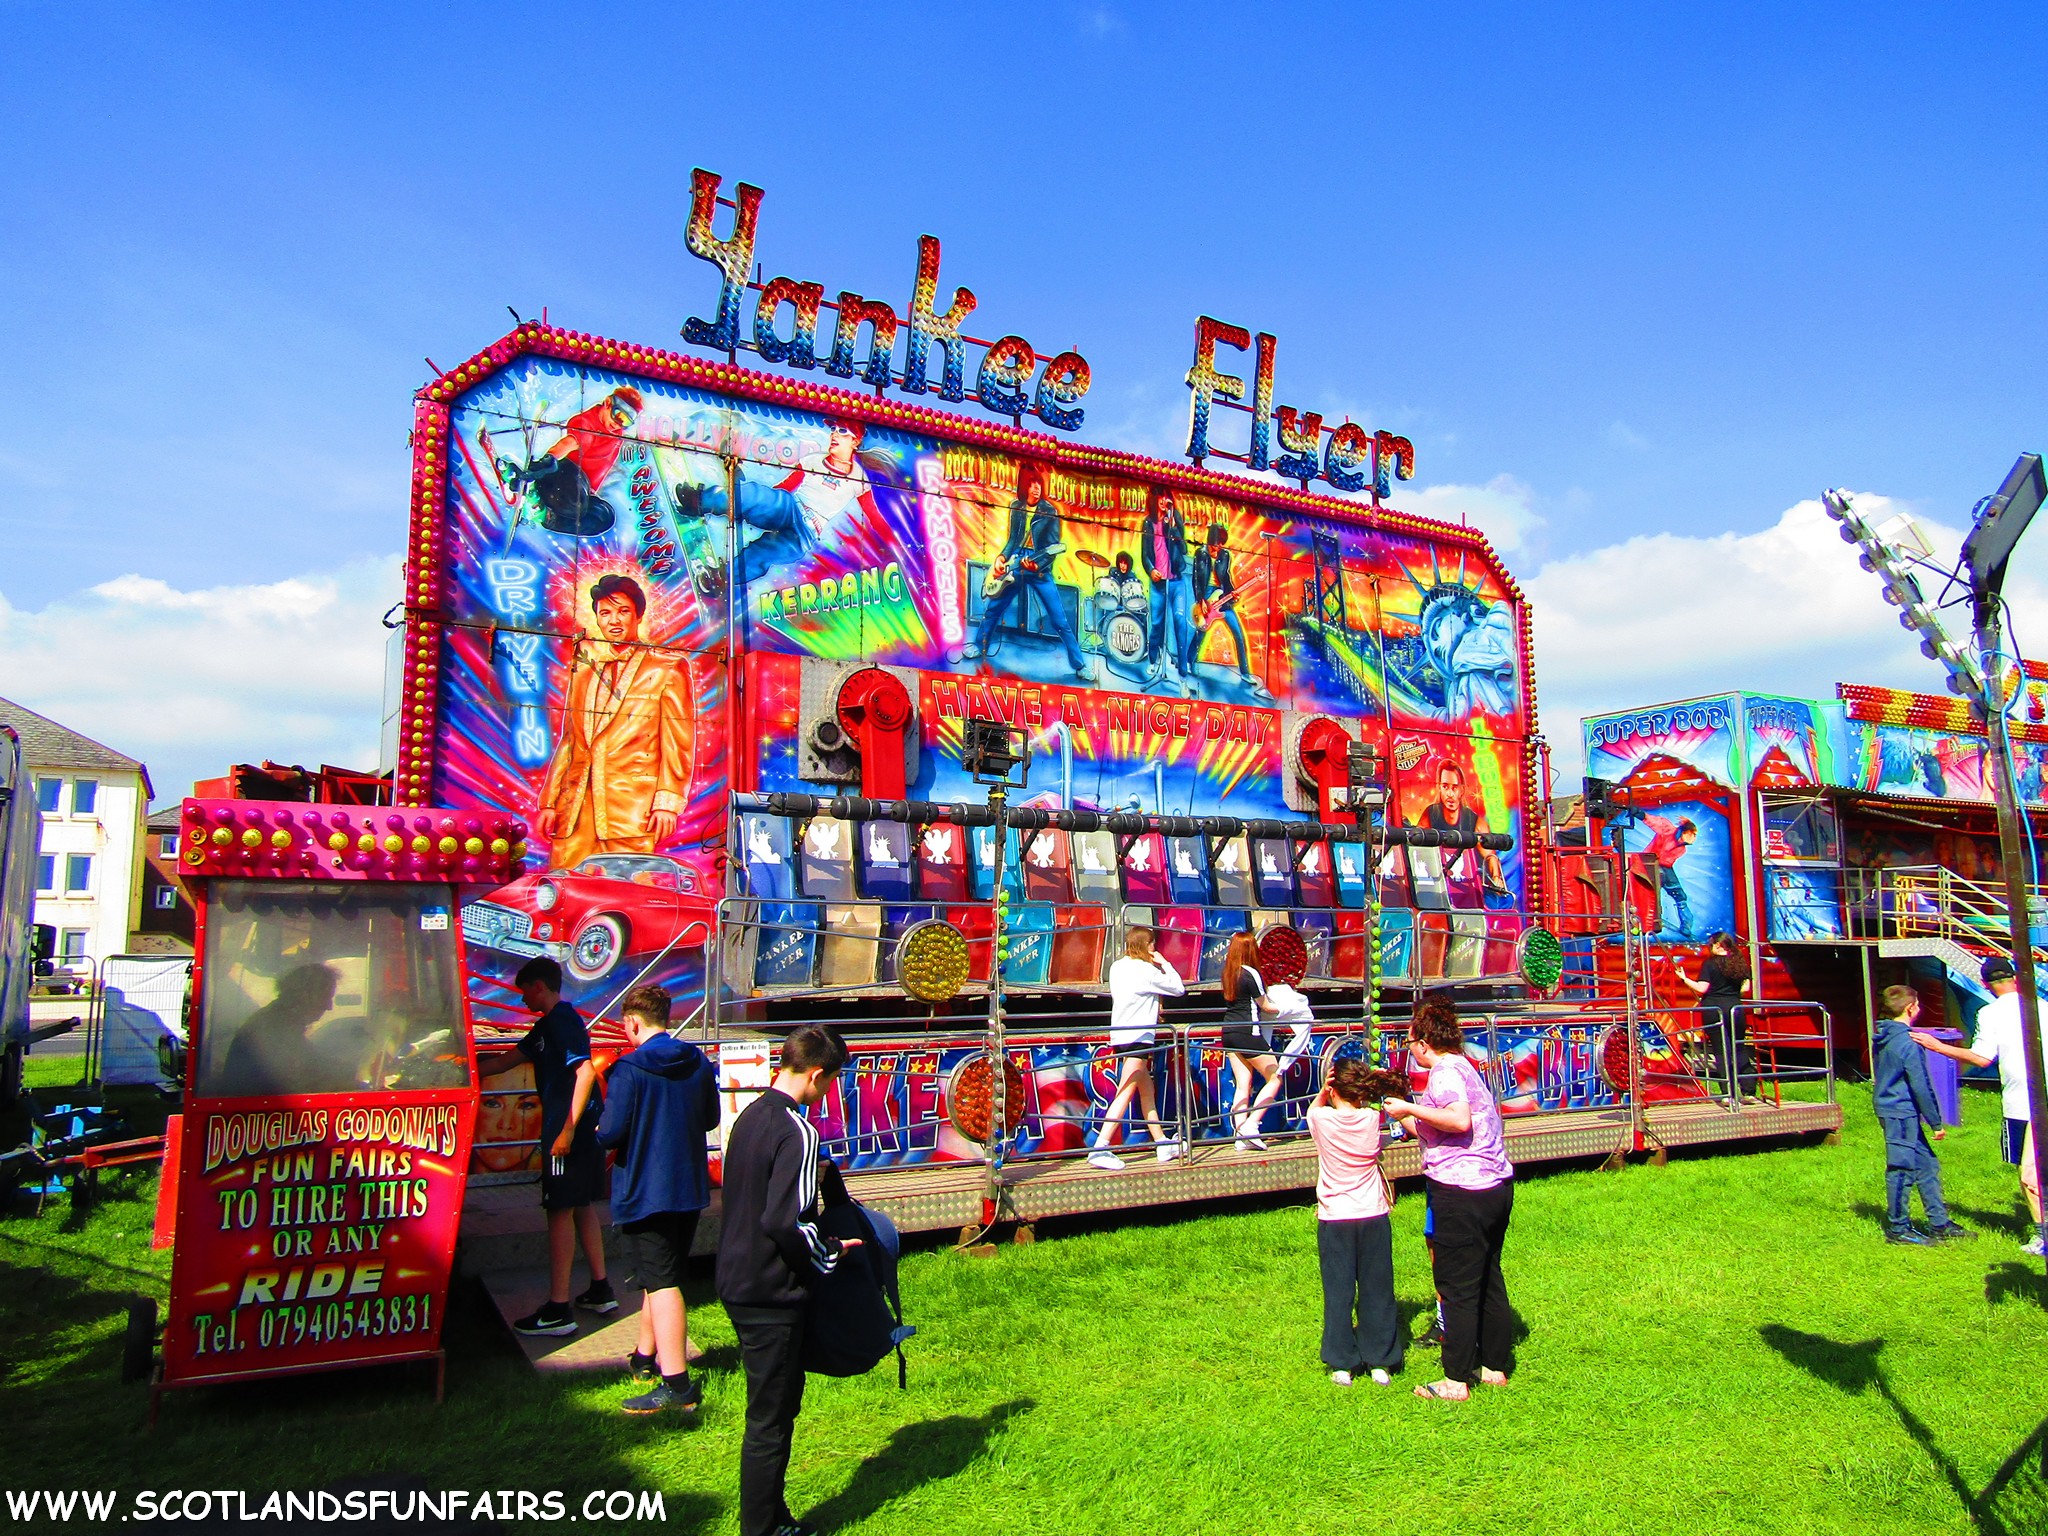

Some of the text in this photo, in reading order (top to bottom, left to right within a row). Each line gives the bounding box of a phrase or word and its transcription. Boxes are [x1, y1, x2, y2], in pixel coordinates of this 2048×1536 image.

[680, 167, 1415, 498] Yankee Flyer
[945, 453, 975, 481] ROCK
[1049, 472, 1076, 506] ROCK
[1089, 484, 1115, 510] ROLL
[1119, 486, 1147, 512] RADIO
[630, 464, 675, 576] AWESOME
[916, 458, 963, 643] RAMONES
[760, 561, 902, 620] KERRANG
[1119, 622, 1134, 633] THE
[488, 559, 545, 760] DRIVE IN
[932, 680, 1273, 746] HAVE A NICE DAY
[1591, 706, 1725, 748] SUPER BOB
[1750, 704, 1799, 733] SUPER BOB
[1007, 932, 1041, 959] ANKEE
[1541, 1024, 1629, 1101] BE
[770, 1051, 940, 1157] AKE
[205, 1106, 457, 1171] DOUGLAS CODONA'S
[252, 1147, 412, 1184] FUN FAIRS
[218, 1178, 428, 1229] TO HIRE THIS
[273, 1224, 384, 1258] OR ANY
[238, 1258, 386, 1305] RIDE
[194, 1294, 431, 1354] Tel. 07940543831
